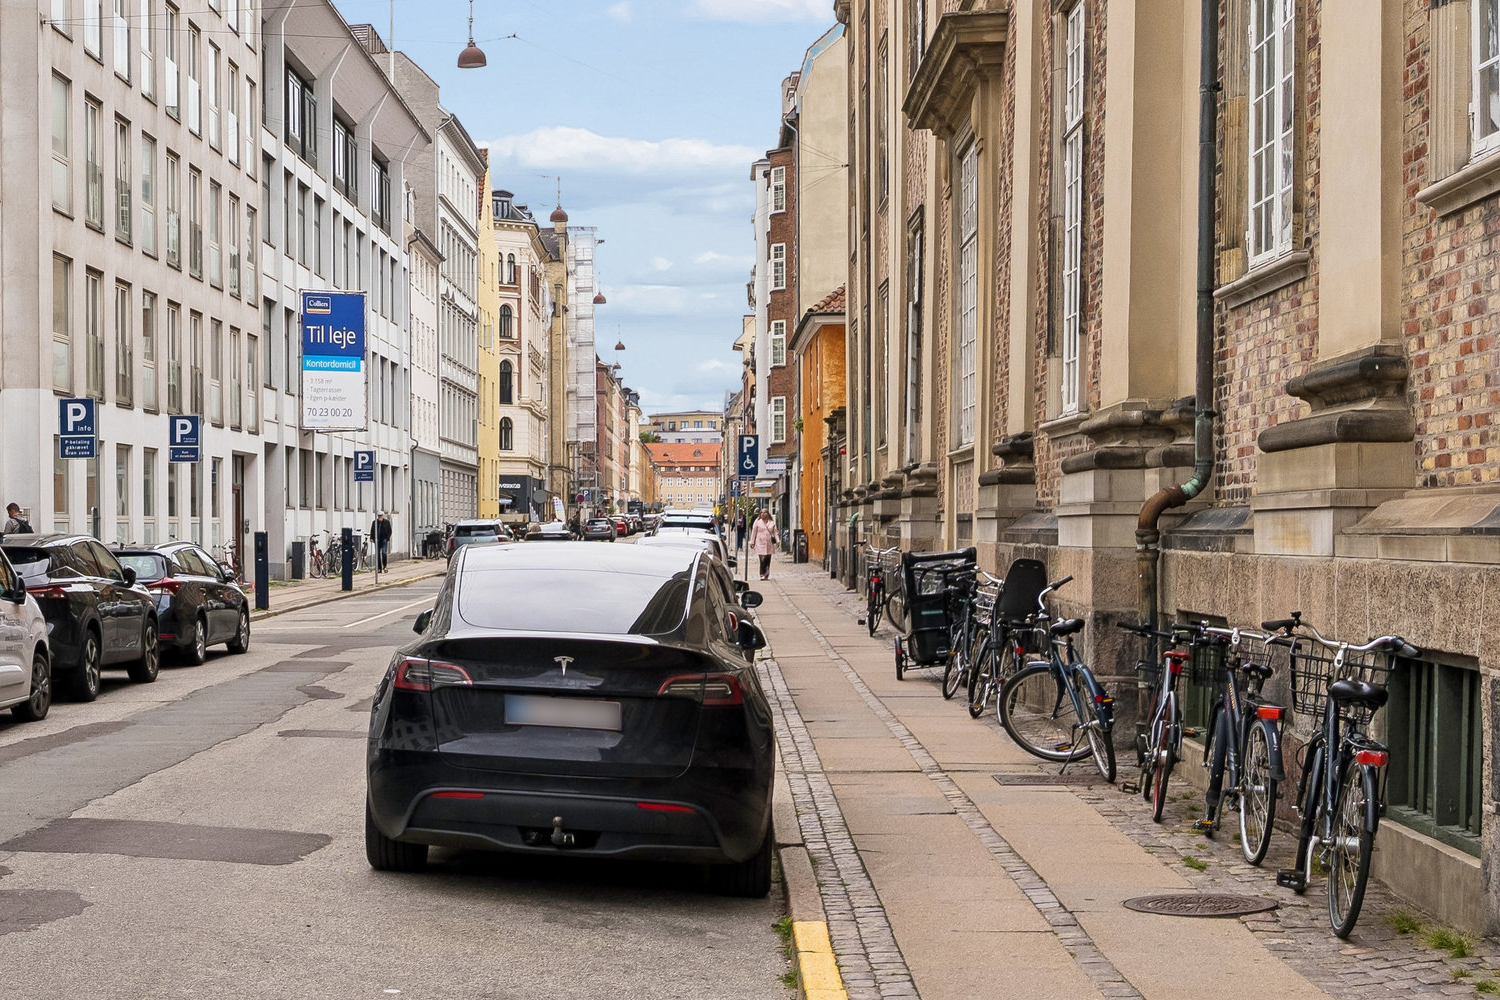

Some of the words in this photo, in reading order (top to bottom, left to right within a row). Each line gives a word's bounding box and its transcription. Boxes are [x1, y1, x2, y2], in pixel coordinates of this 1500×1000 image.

[306, 325, 324, 343] Til
[329, 325, 356, 348] leje
[306, 359, 356, 369] Kontordomicil
[67, 403, 86, 432] P
[307, 407, 317, 417] 70
[319, 407, 329, 417] 23
[330, 407, 341, 417] 00
[342, 408, 353, 417] 20
[175, 419, 192, 443] P
[743, 436, 755, 453] P
[358, 453, 370, 469] P
